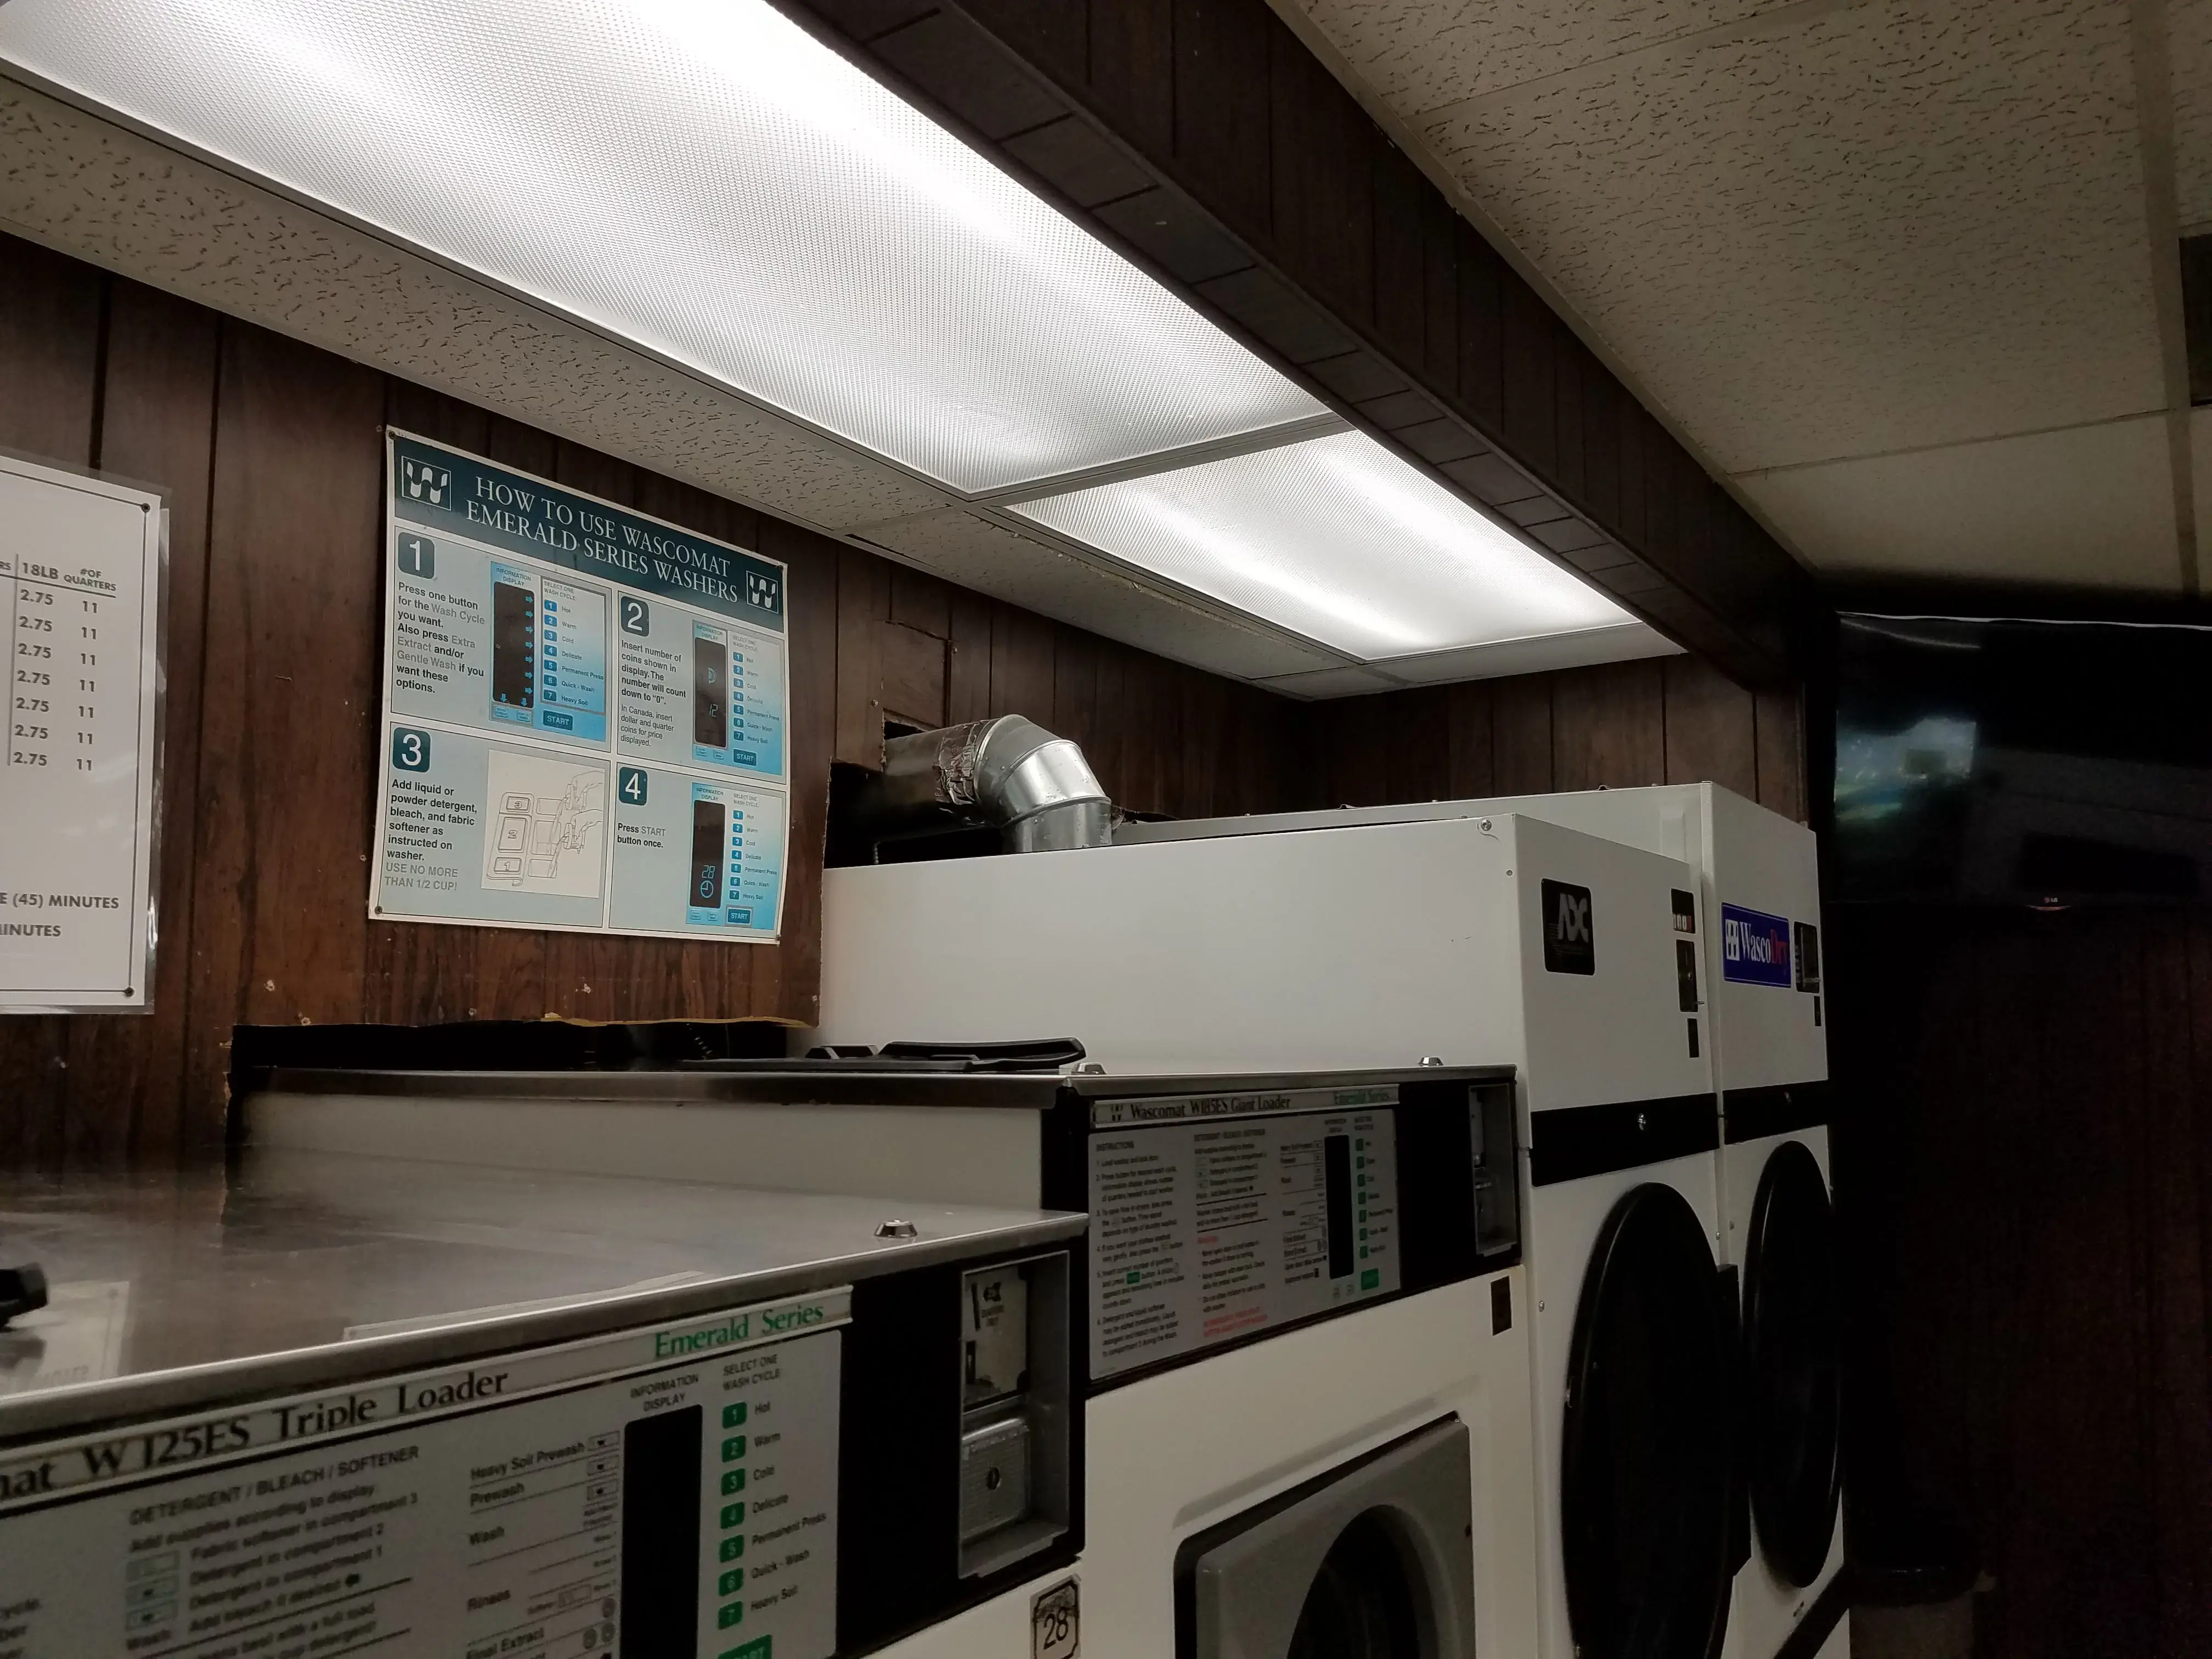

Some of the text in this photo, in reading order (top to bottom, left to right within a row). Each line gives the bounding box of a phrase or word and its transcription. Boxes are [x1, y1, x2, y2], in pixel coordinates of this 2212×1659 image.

[476, 476, 730, 577] HOW TO USE WASCOMAT
[409, 540, 420, 571] 1
[466, 500, 738, 603] EMERALD SERIES WASHERS
[22, 562, 59, 579] 18LB
[80, 568, 102, 578] #OF
[496, 567, 531, 581] INFORMATION
[64, 574, 116, 591] QUARTERS
[503, 576, 524, 586] DISPLAY
[20, 589, 98, 613] 2.75 11
[398, 582, 478, 610] Press one button
[398, 595, 484, 624] for the Wash Cycle
[628, 602, 643, 631] 2
[19, 616, 97, 640] 2.75 11
[398, 611, 443, 628] you want.
[562, 621, 577, 629] Warm
[398, 623, 475, 648] Also press Extra
[18, 643, 95, 665] 2.75 11
[397, 636, 464, 658] Extract and/or
[622, 640, 643, 652] Insert
[645, 647, 672, 660] number
[397, 650, 483, 676] Gentle Wash if you
[562, 651, 582, 661] Delicate
[622, 653, 676, 673] coins shown in
[17, 670, 95, 692] 2.75 11
[397, 665, 448, 682] want these
[562, 666, 589, 677] Permanent
[590, 672, 603, 680] Press
[622, 664, 664, 681] display. The
[396, 679, 435, 693] options.
[622, 676, 686, 698] number will count
[562, 696, 577, 706] Heavy
[622, 689, 641, 699] down
[644, 693, 651, 701] to
[16, 697, 94, 718] 2.75 11
[629, 706, 654, 718] Canada,
[656, 712, 672, 722] insert
[547, 715, 569, 725] START
[621, 715, 637, 724] dollar
[653, 721, 674, 732] quarter
[14, 724, 93, 744] 2.75 11
[621, 735, 651, 747] displayed.
[648, 731, 663, 739] price
[402, 734, 421, 766] 3
[737, 753, 754, 761] START
[13, 752, 92, 771] 2.75 11
[392, 779, 411, 789] Add
[415, 782, 441, 794] liquid
[625, 772, 641, 799] 4
[391, 794, 477, 814] powder detergent,
[390, 806, 475, 826] bleach, and fabric
[389, 822, 430, 833] softener
[508, 830, 517, 838] 2
[618, 823, 665, 836] Press START
[388, 834, 437, 848] instructed
[618, 835, 641, 845] button
[387, 850, 424, 860] washer.
[386, 862, 458, 877] USE NO MORE
[505, 861, 510, 870] 1
[702, 865, 715, 878] 28
[385, 876, 457, 890] THAN 1/2 CUP!
[13, 893, 43, 908] (45)
[49, 895, 119, 909] MINUTES
[0, 924, 61, 936] INUTES
[1130, 1104, 1185, 1119] Wascomat
[1258, 1096, 1290, 1109] Loader
[273, 1395, 378, 1442] Triple
[397, 1370, 509, 1414] Loader
[654, 1313, 749, 1359] Emerald
[761, 1305, 824, 1335] Series
[723, 1358, 757, 1376] SELECT
[630, 1374, 698, 1397] INFORMATION
[723, 1376, 749, 1391] WASH
[643, 1393, 685, 1411] DISPLAY
[338, 1446, 418, 1476] SOFTENER
[1043, 1606, 1069, 1650] 28
